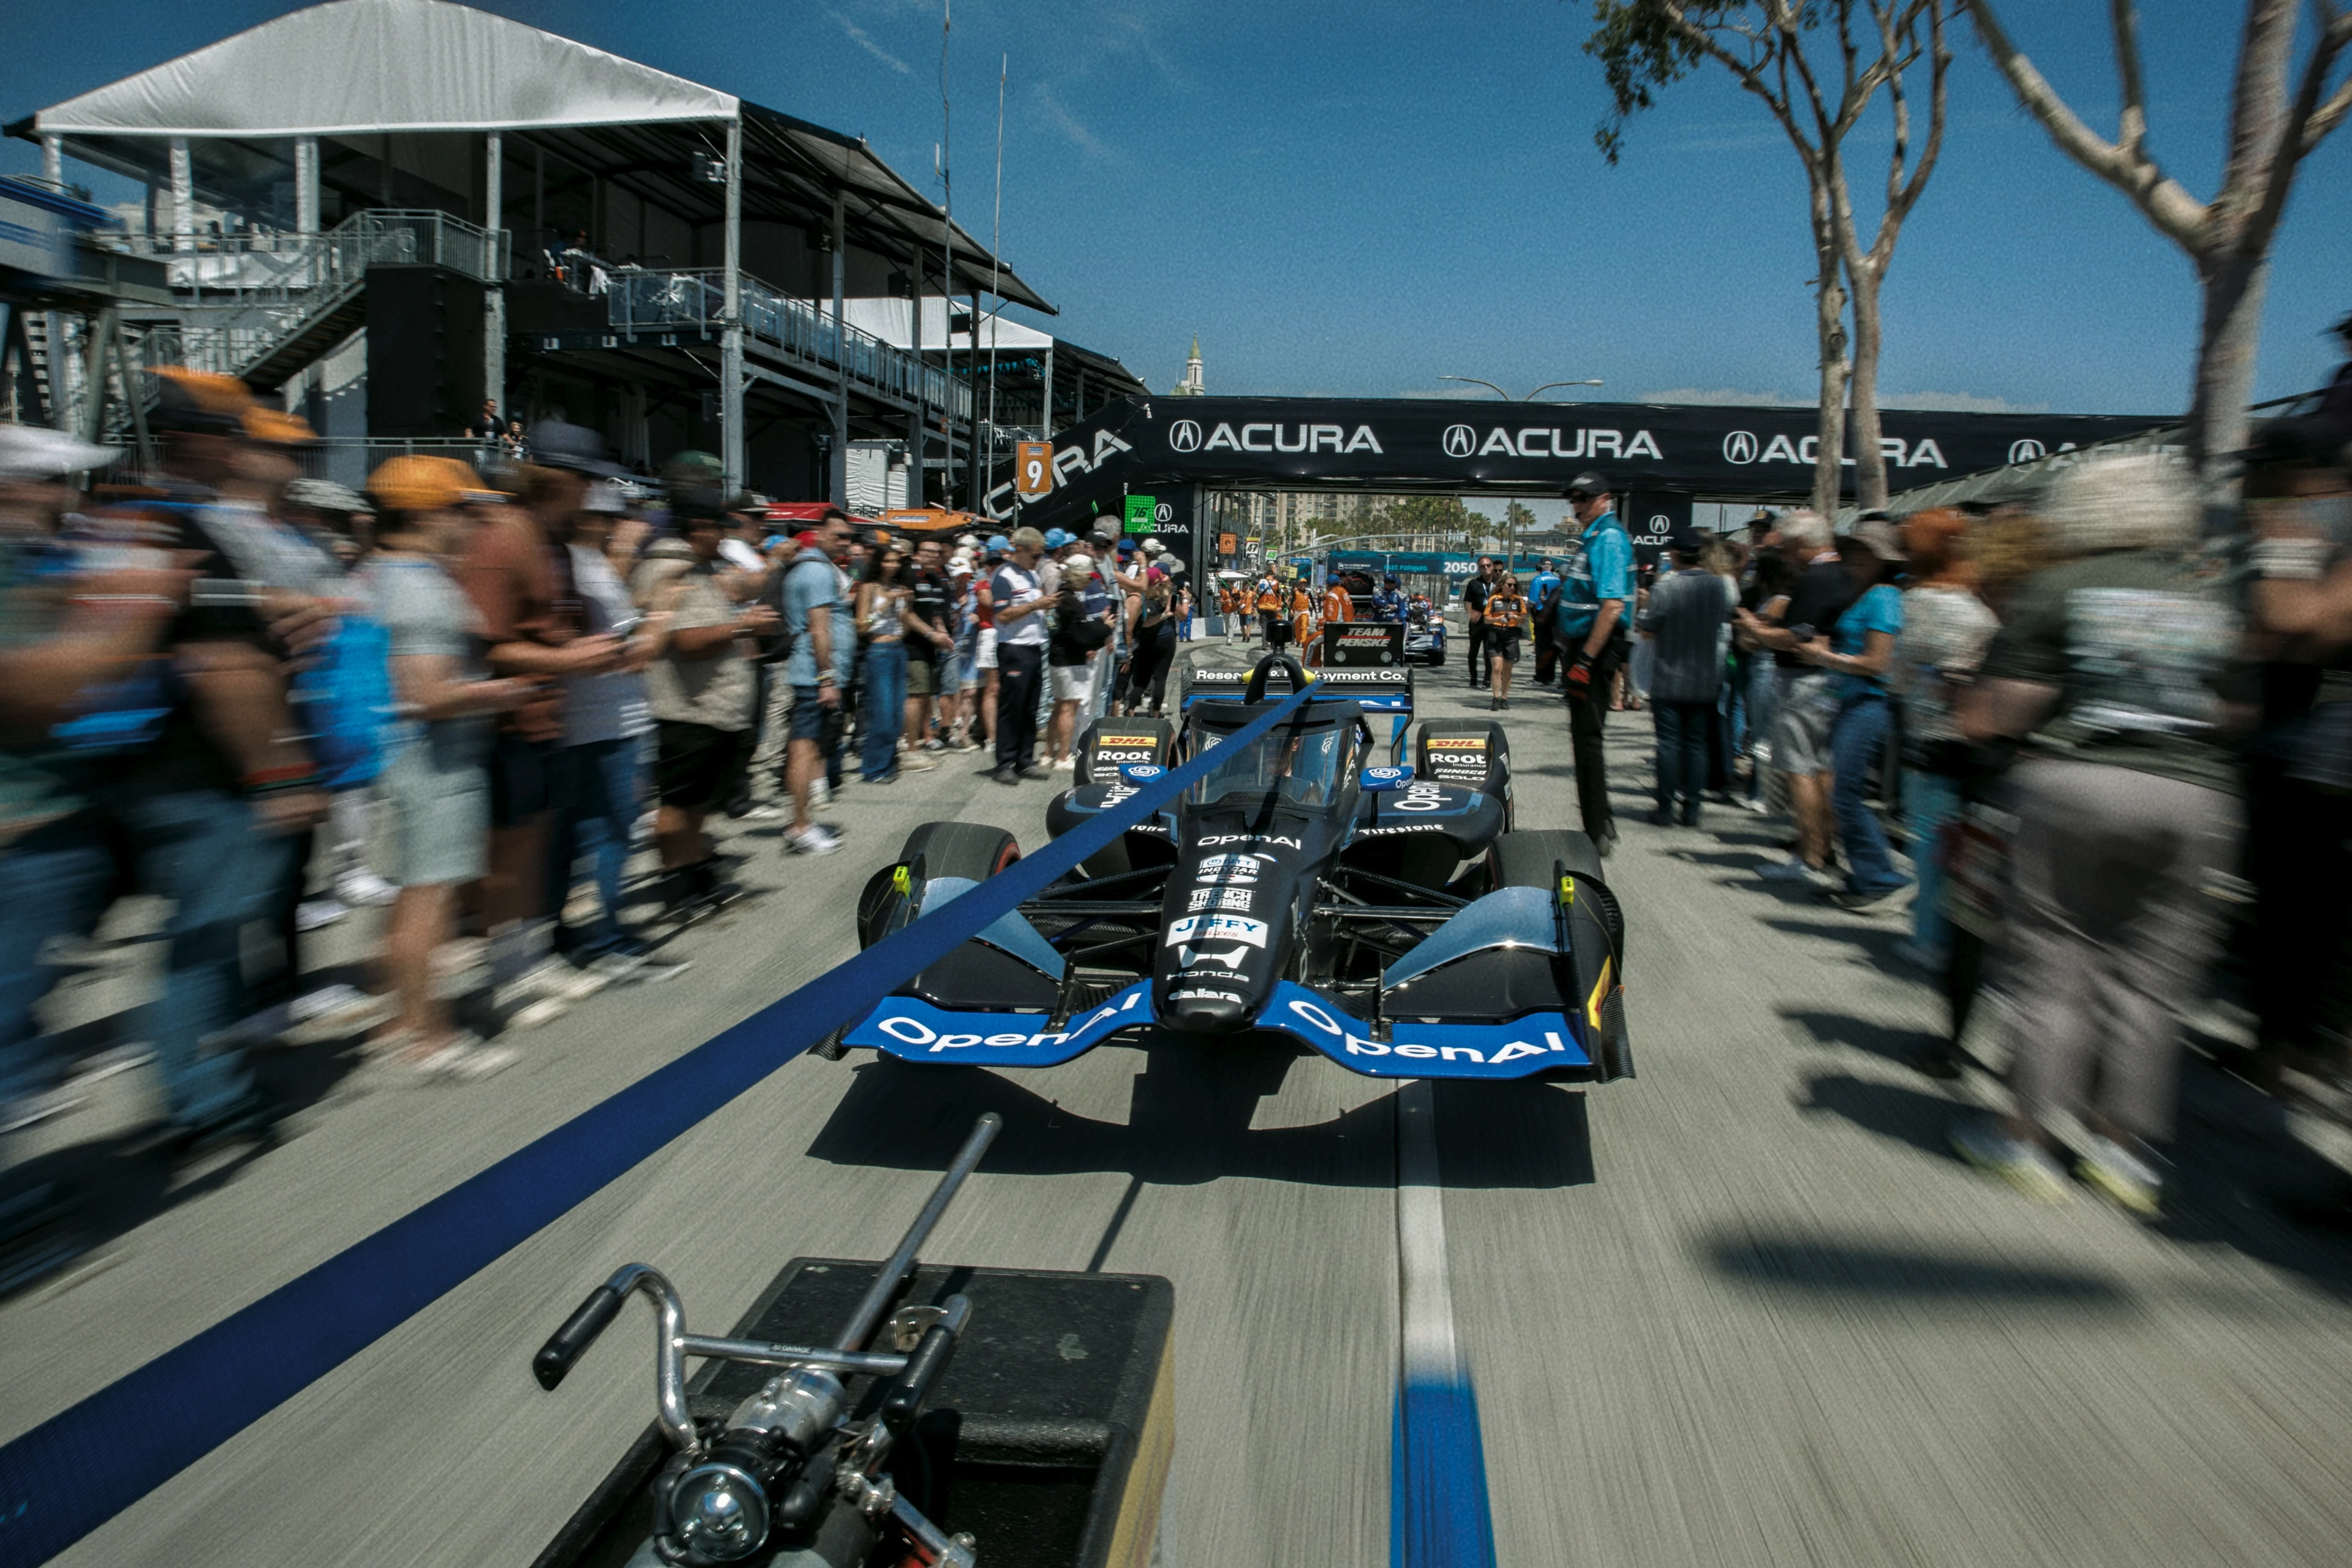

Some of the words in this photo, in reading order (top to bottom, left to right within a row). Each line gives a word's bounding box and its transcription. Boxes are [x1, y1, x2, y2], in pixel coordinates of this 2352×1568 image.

[1204, 423, 1384, 454] ACURA
[1478, 427, 1663, 459] ACURA
[1758, 434, 1948, 469] ACRA
[1027, 459, 1043, 489] 9
[1444, 562, 1477, 573] 2050
[1348, 628, 1386, 636] TEAM
[1336, 638, 1390, 647] PENSKE
[1379, 670, 1405, 680] Co.
[1097, 750, 1152, 761] Root
[1430, 753, 1487, 764] Root
[1359, 824, 1444, 835] Firestone
[1197, 834, 1301, 850] OpenAI
[1198, 866, 1258, 875] INDYCAR
[1191, 889, 1252, 901] TRENCH
[1188, 898, 1251, 909] SHORING
[1193, 929, 1238, 938] mixes
[878, 992, 1142, 1052] OpenAI
[1288, 1000, 1566, 1063] OpenAI
